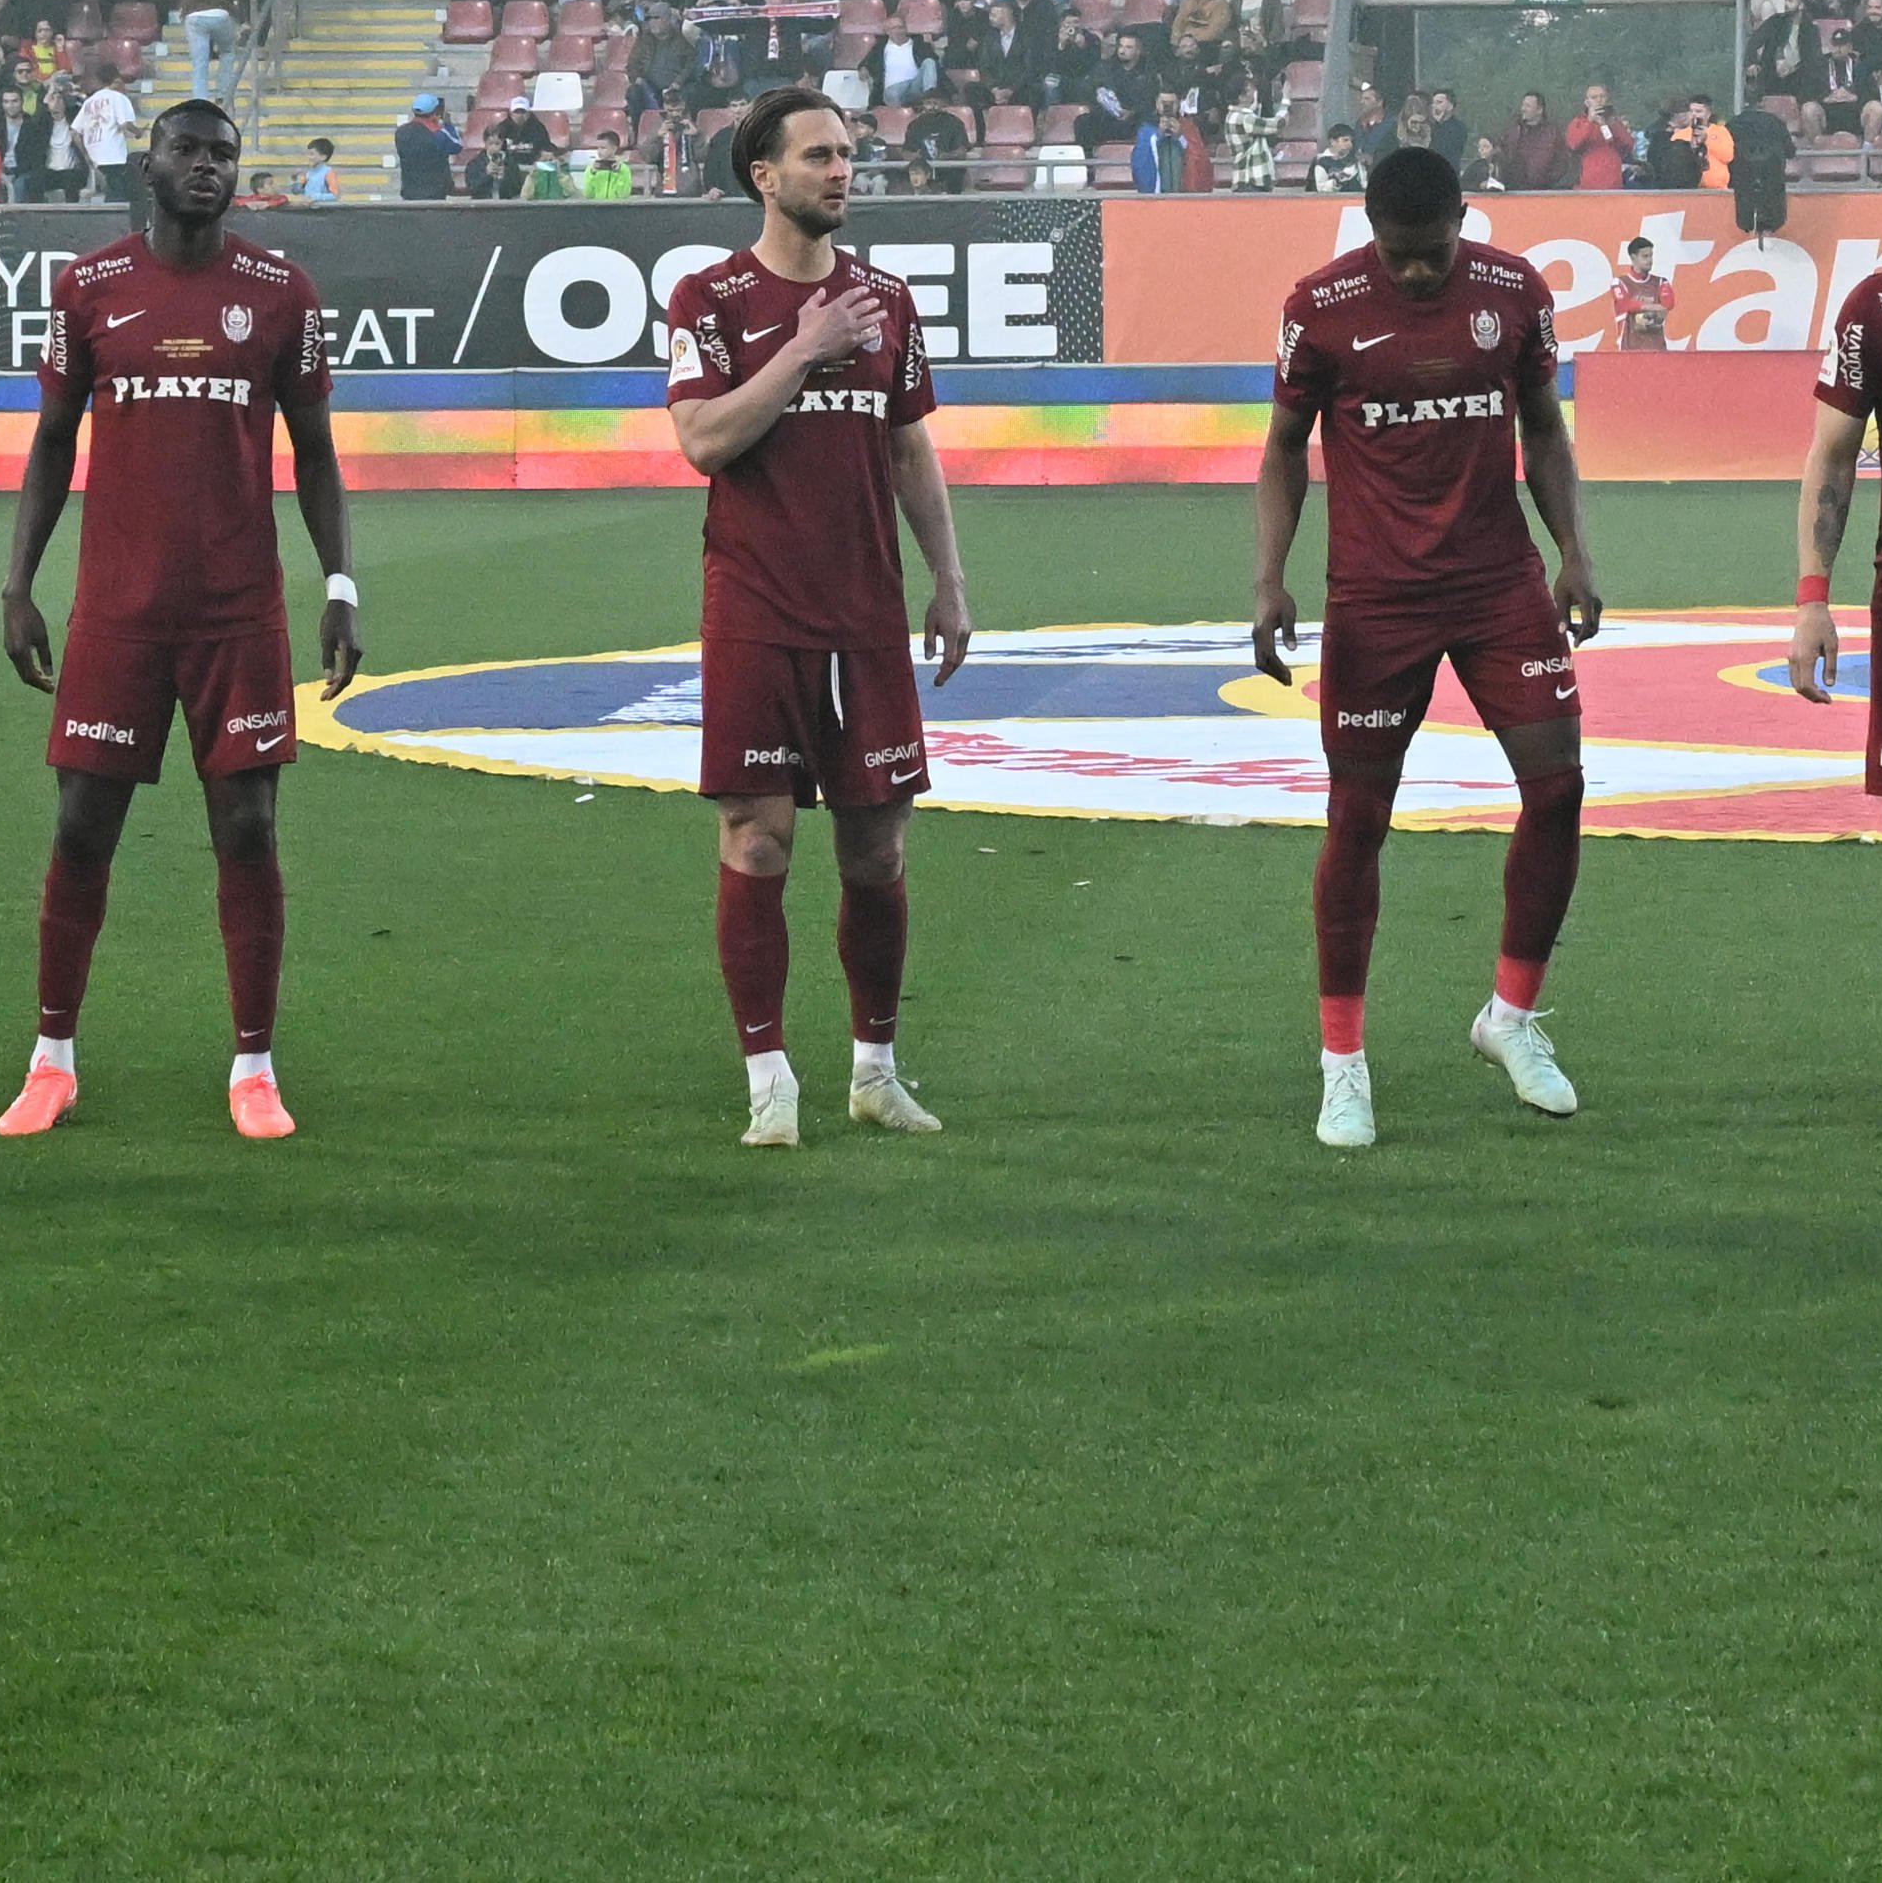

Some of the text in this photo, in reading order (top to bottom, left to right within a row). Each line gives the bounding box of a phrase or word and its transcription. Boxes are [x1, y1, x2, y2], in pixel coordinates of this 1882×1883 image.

[53, 309, 67, 376] AQUAVIA
[300, 308, 315, 376] AQUAVIA
[1849, 323, 1865, 391] AQUAVIA
[111, 375, 252, 407] PLAYER
[1361, 389, 1504, 428] PLAYER
[65, 719, 136, 747] peditel
[226, 710, 289, 736] GINSAVIT
[865, 742, 920, 769] GINSAVIT
